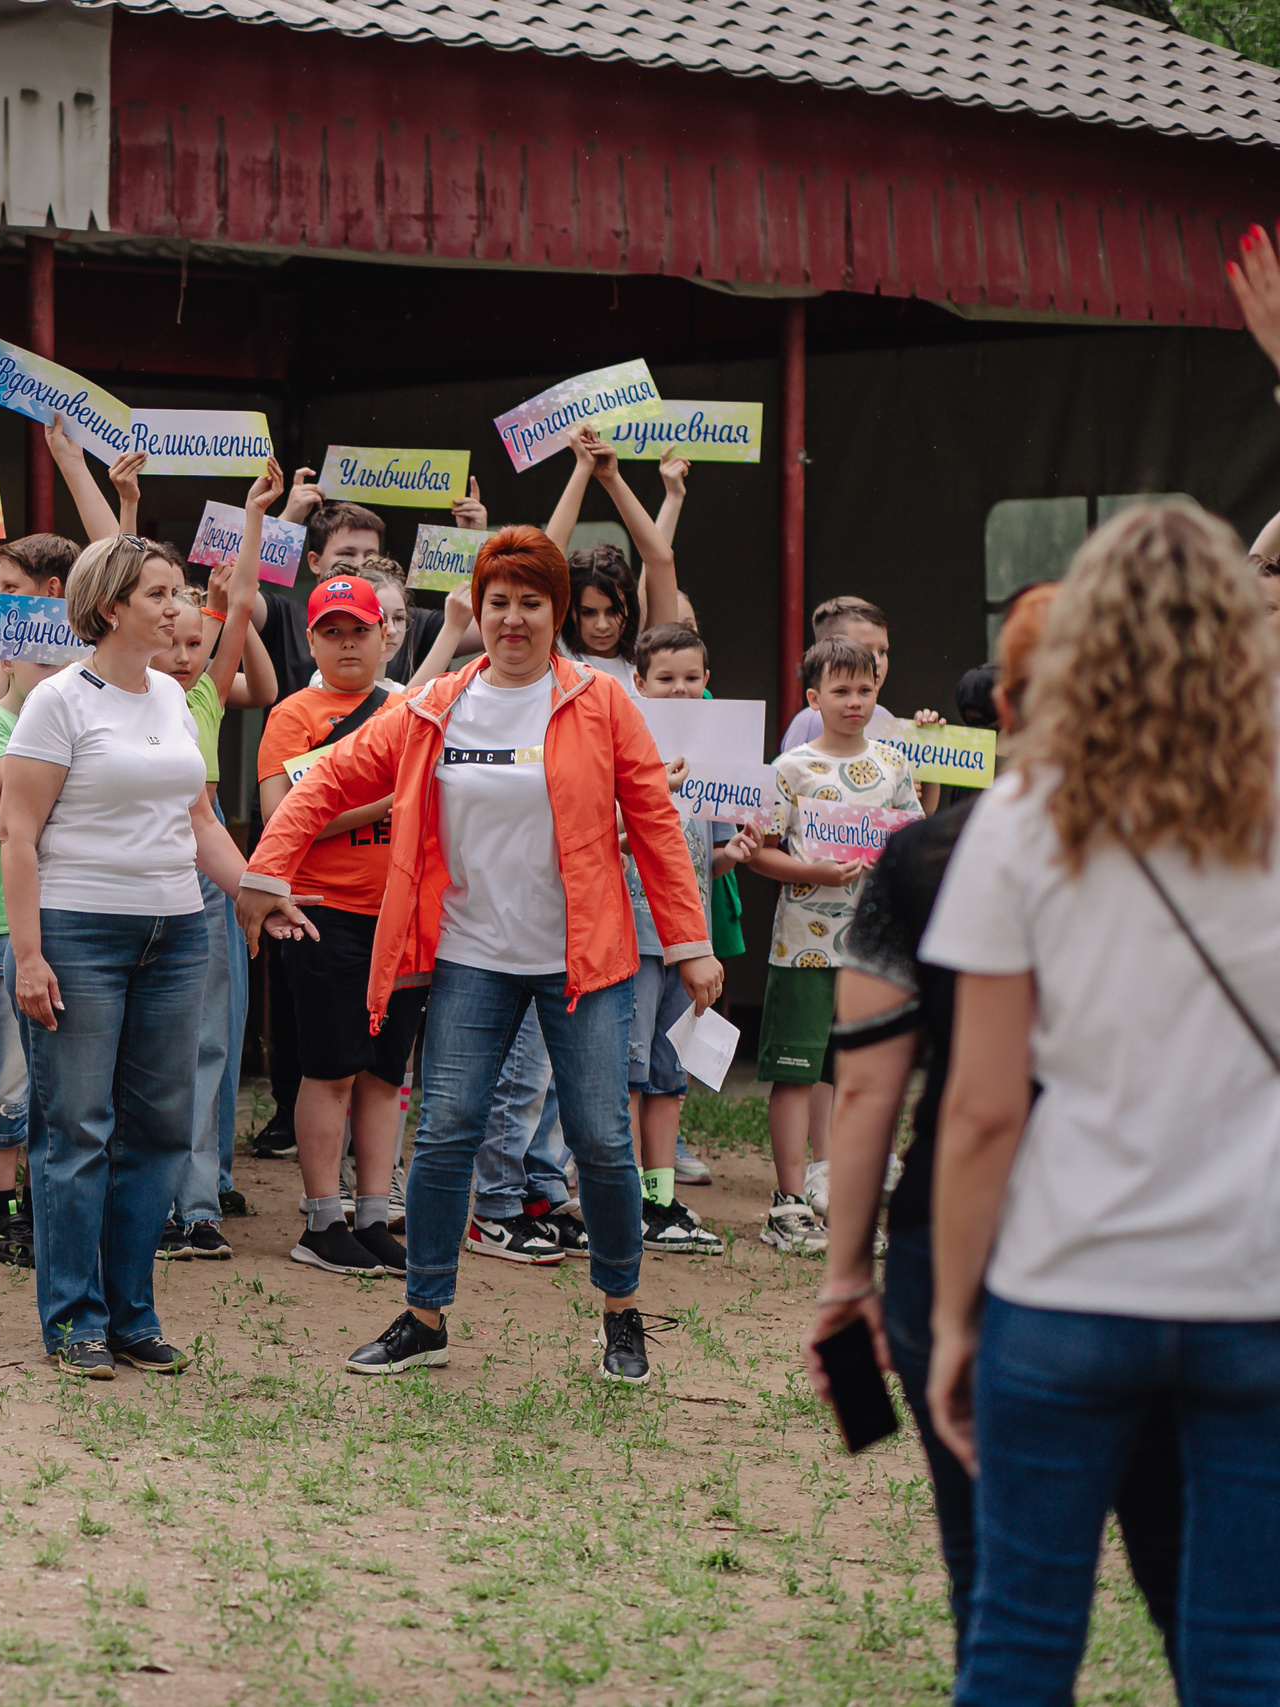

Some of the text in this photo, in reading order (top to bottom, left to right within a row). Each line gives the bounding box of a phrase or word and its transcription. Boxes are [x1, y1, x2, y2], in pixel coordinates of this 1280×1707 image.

[503, 381, 656, 461] Трогательная
[612, 411, 750, 454] Душевная
[131, 423, 272, 458] Великолепная
[340, 458, 452, 492] Улыбчивая
[324, 592, 354, 602] LADA
[450, 750, 494, 762] CHIC
